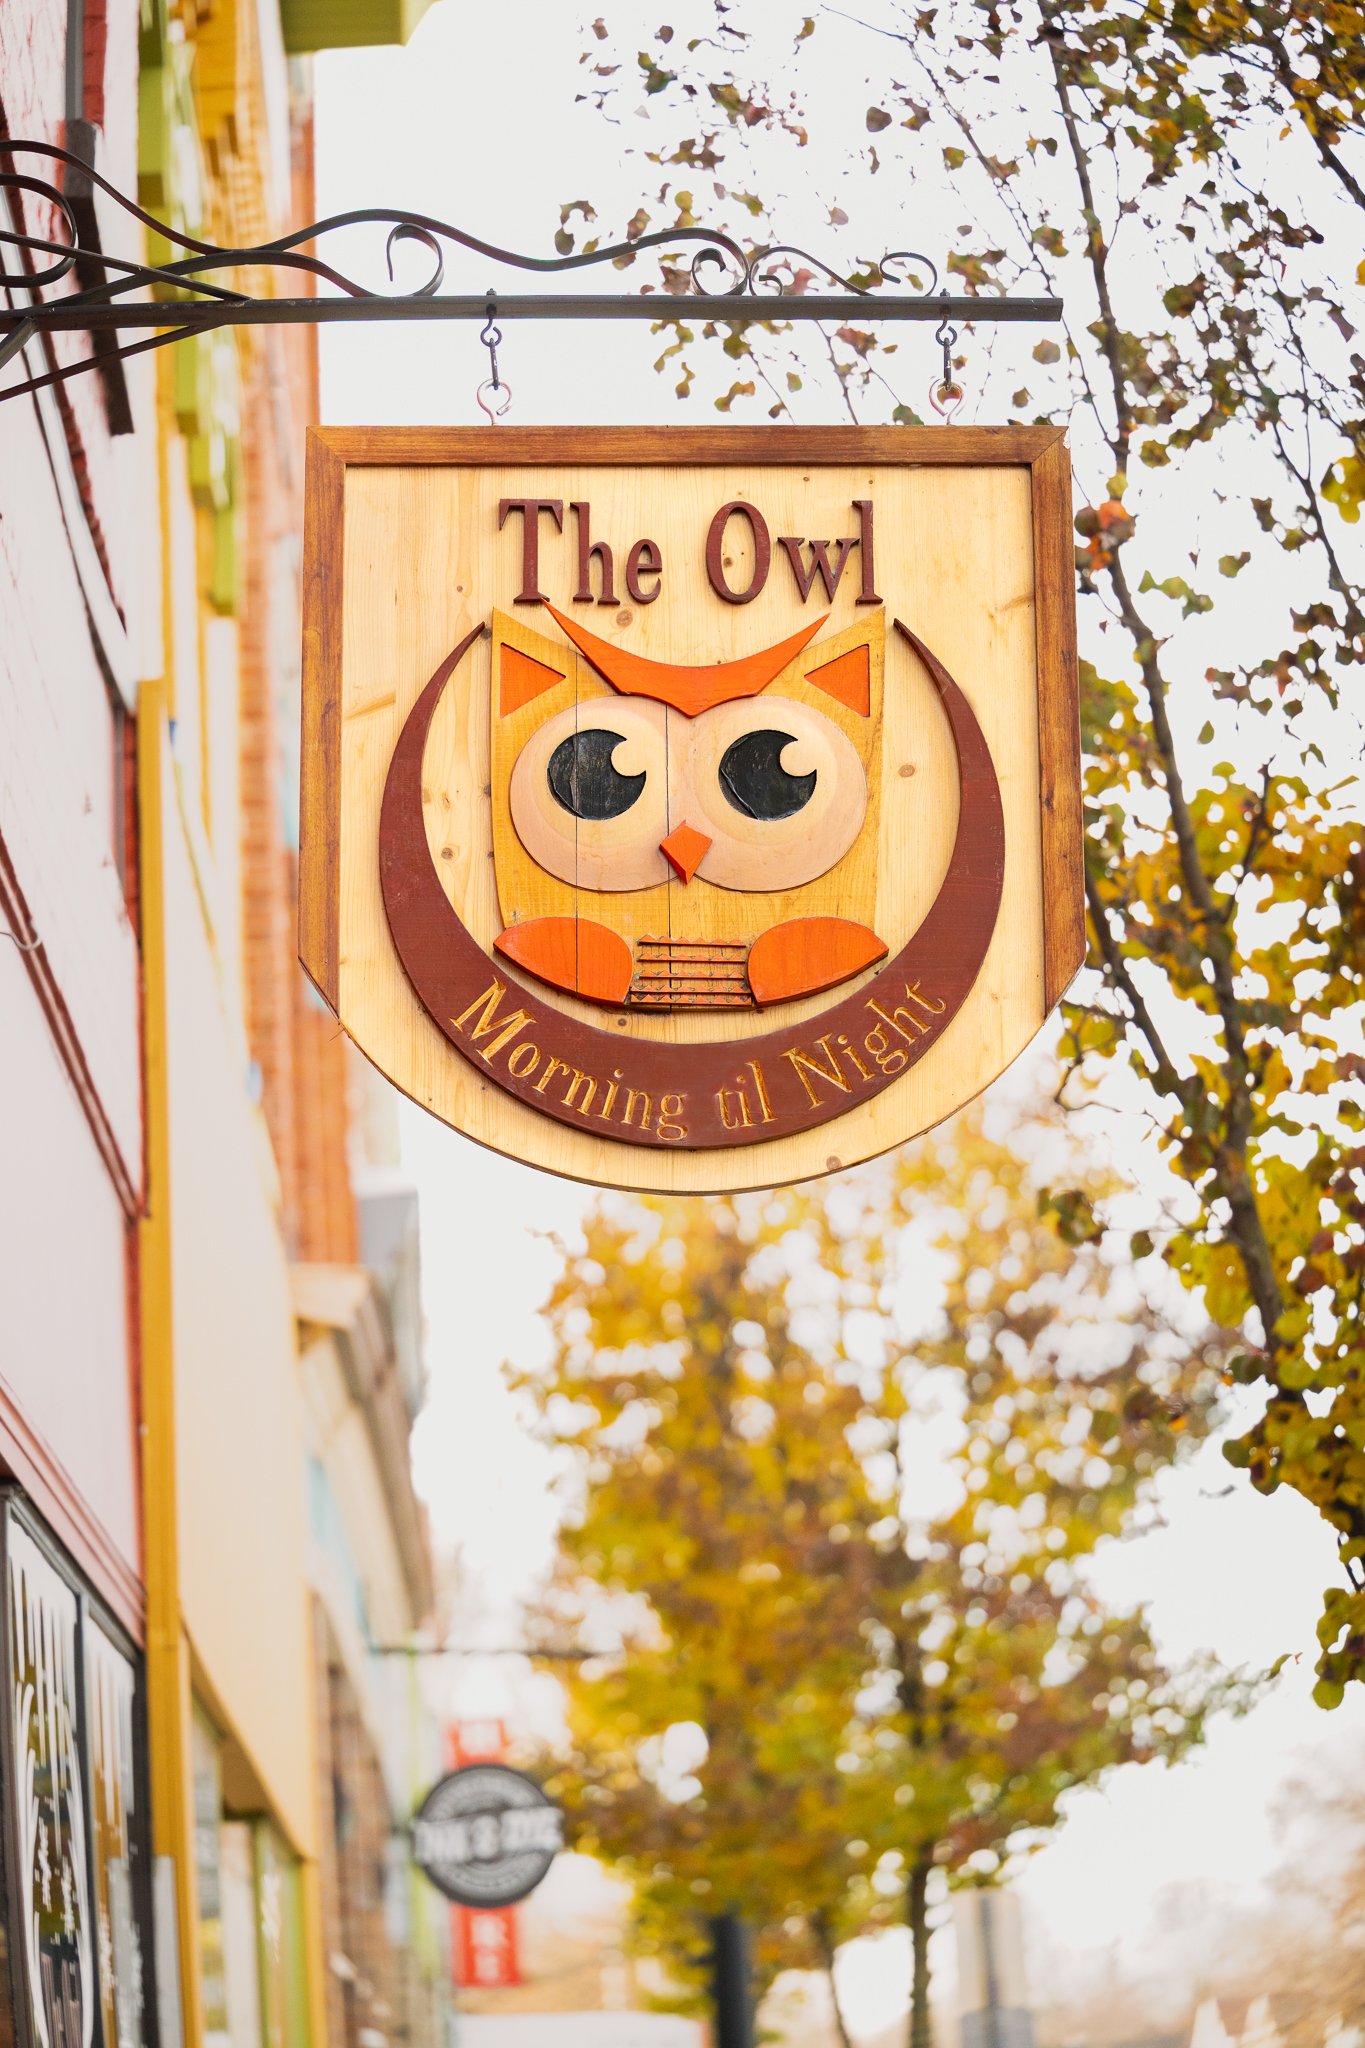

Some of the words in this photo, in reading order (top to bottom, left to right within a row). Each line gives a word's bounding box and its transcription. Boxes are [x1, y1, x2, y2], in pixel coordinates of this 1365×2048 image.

[499, 498, 662, 605] The
[706, 499, 883, 605] Owl
[449, 976, 689, 1141] Morning
[715, 1060, 778, 1129] til
[780, 979, 947, 1110] Night
